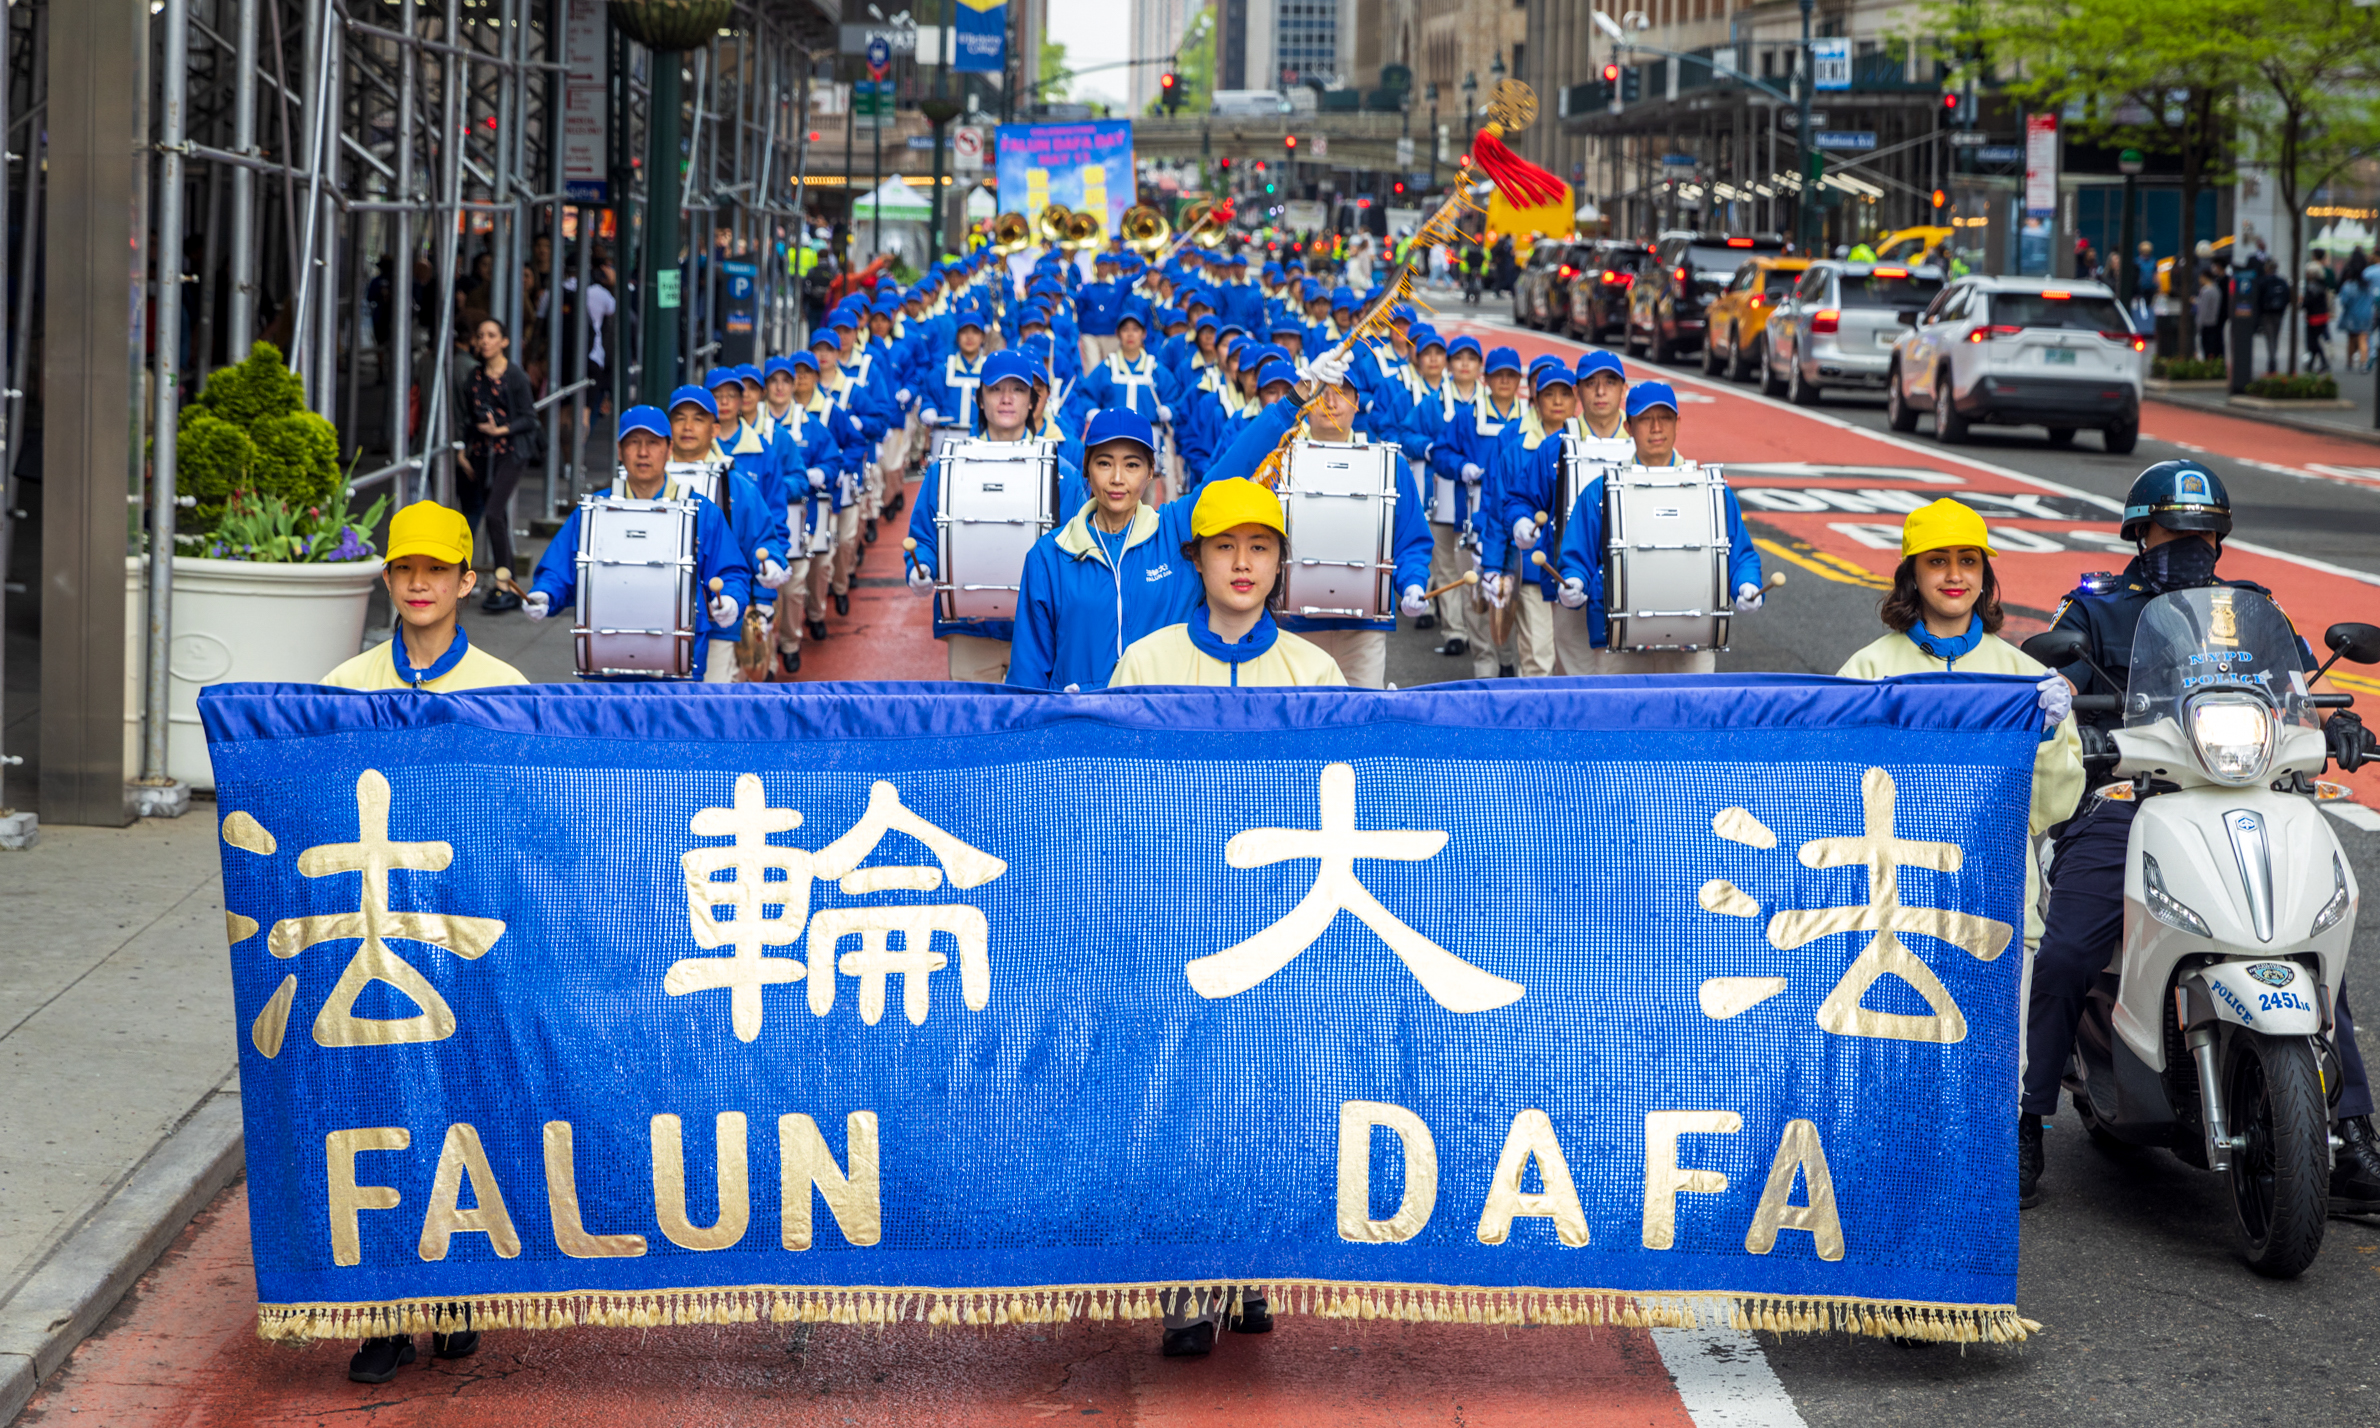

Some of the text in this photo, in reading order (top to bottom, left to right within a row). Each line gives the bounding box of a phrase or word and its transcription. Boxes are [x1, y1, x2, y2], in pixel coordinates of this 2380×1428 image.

[1001, 131, 1125, 152] FALUN DAFA DAY
[1817, 133, 1855, 146] Madison
[1039, 153, 1070, 165] MAY
[2188, 651, 2253, 666] NYPD
[2183, 672, 2267, 689] POLICE
[2211, 980, 2253, 1025] POLICE
[325, 1099, 1845, 1266] FALUN DAFA
